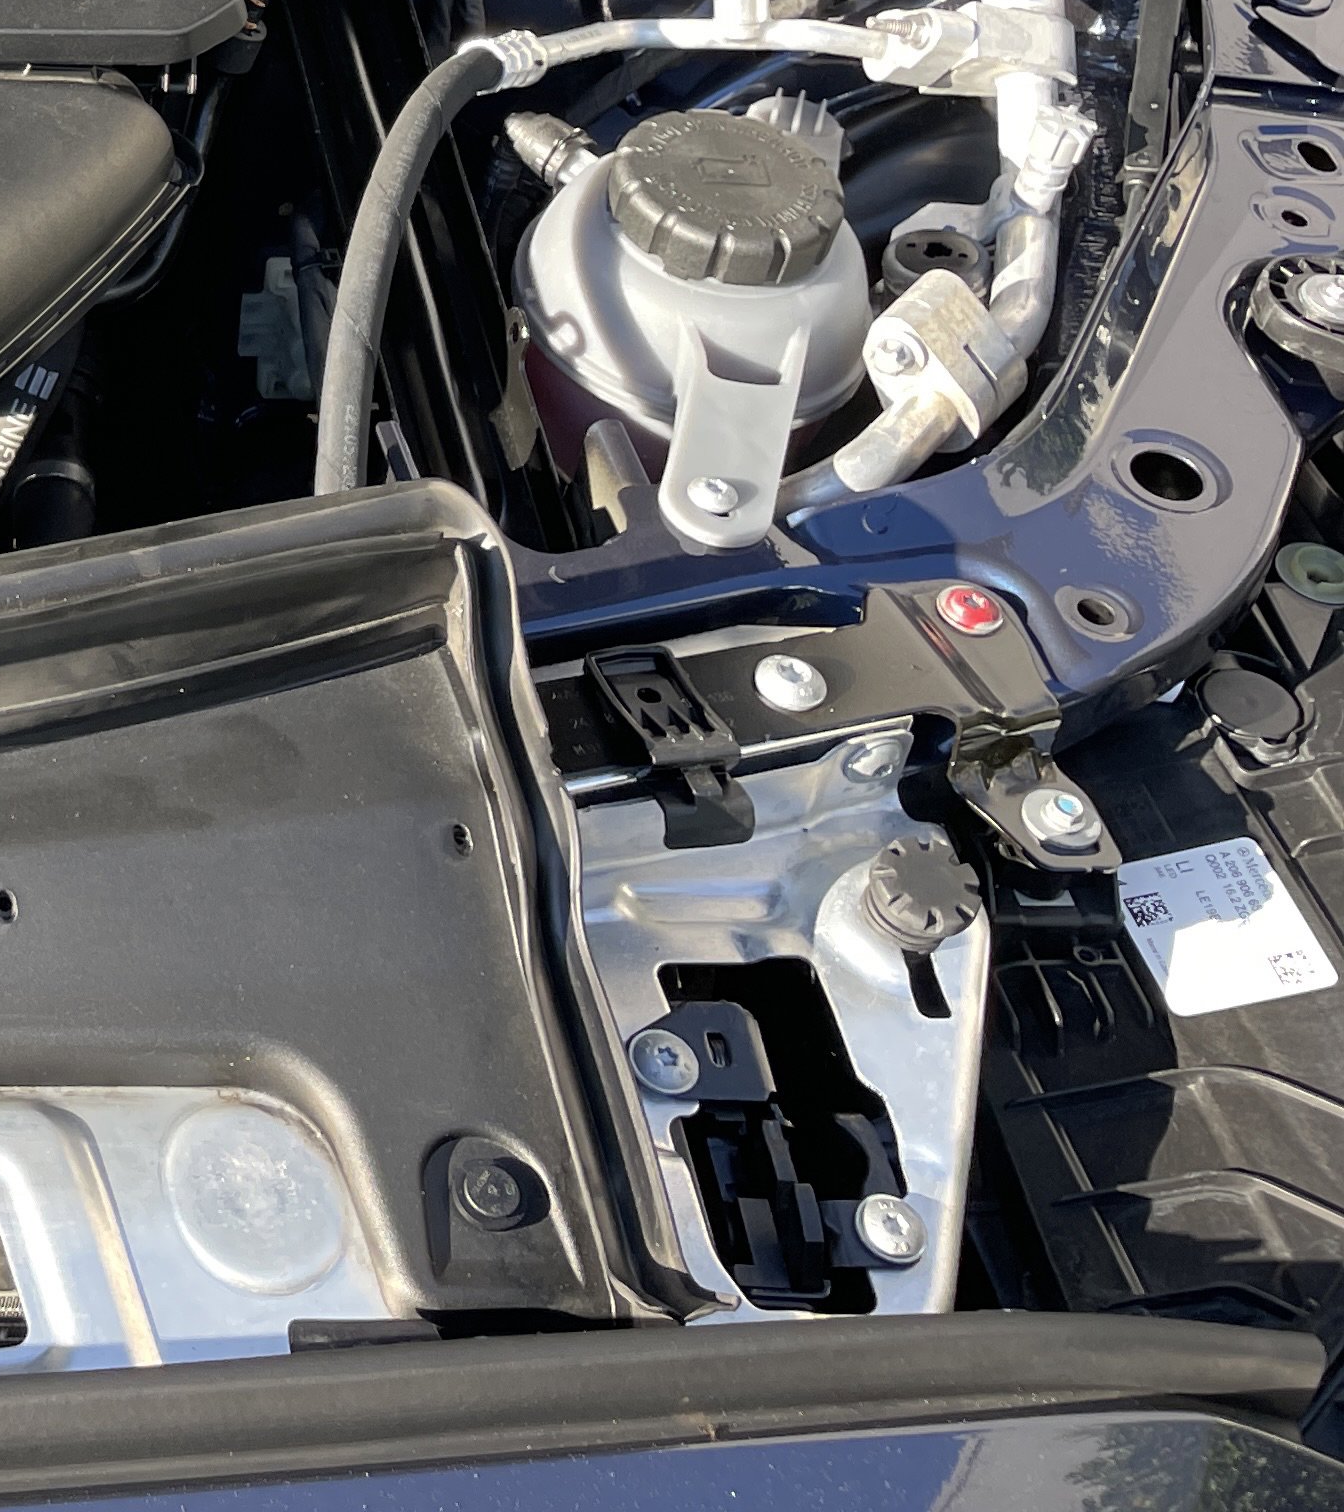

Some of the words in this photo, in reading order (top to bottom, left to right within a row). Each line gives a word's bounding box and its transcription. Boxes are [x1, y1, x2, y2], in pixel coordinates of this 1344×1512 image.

[1219, 851, 1232, 859] A
[1205, 854, 1227, 879] Q002
[1224, 860, 1243, 879] 206
